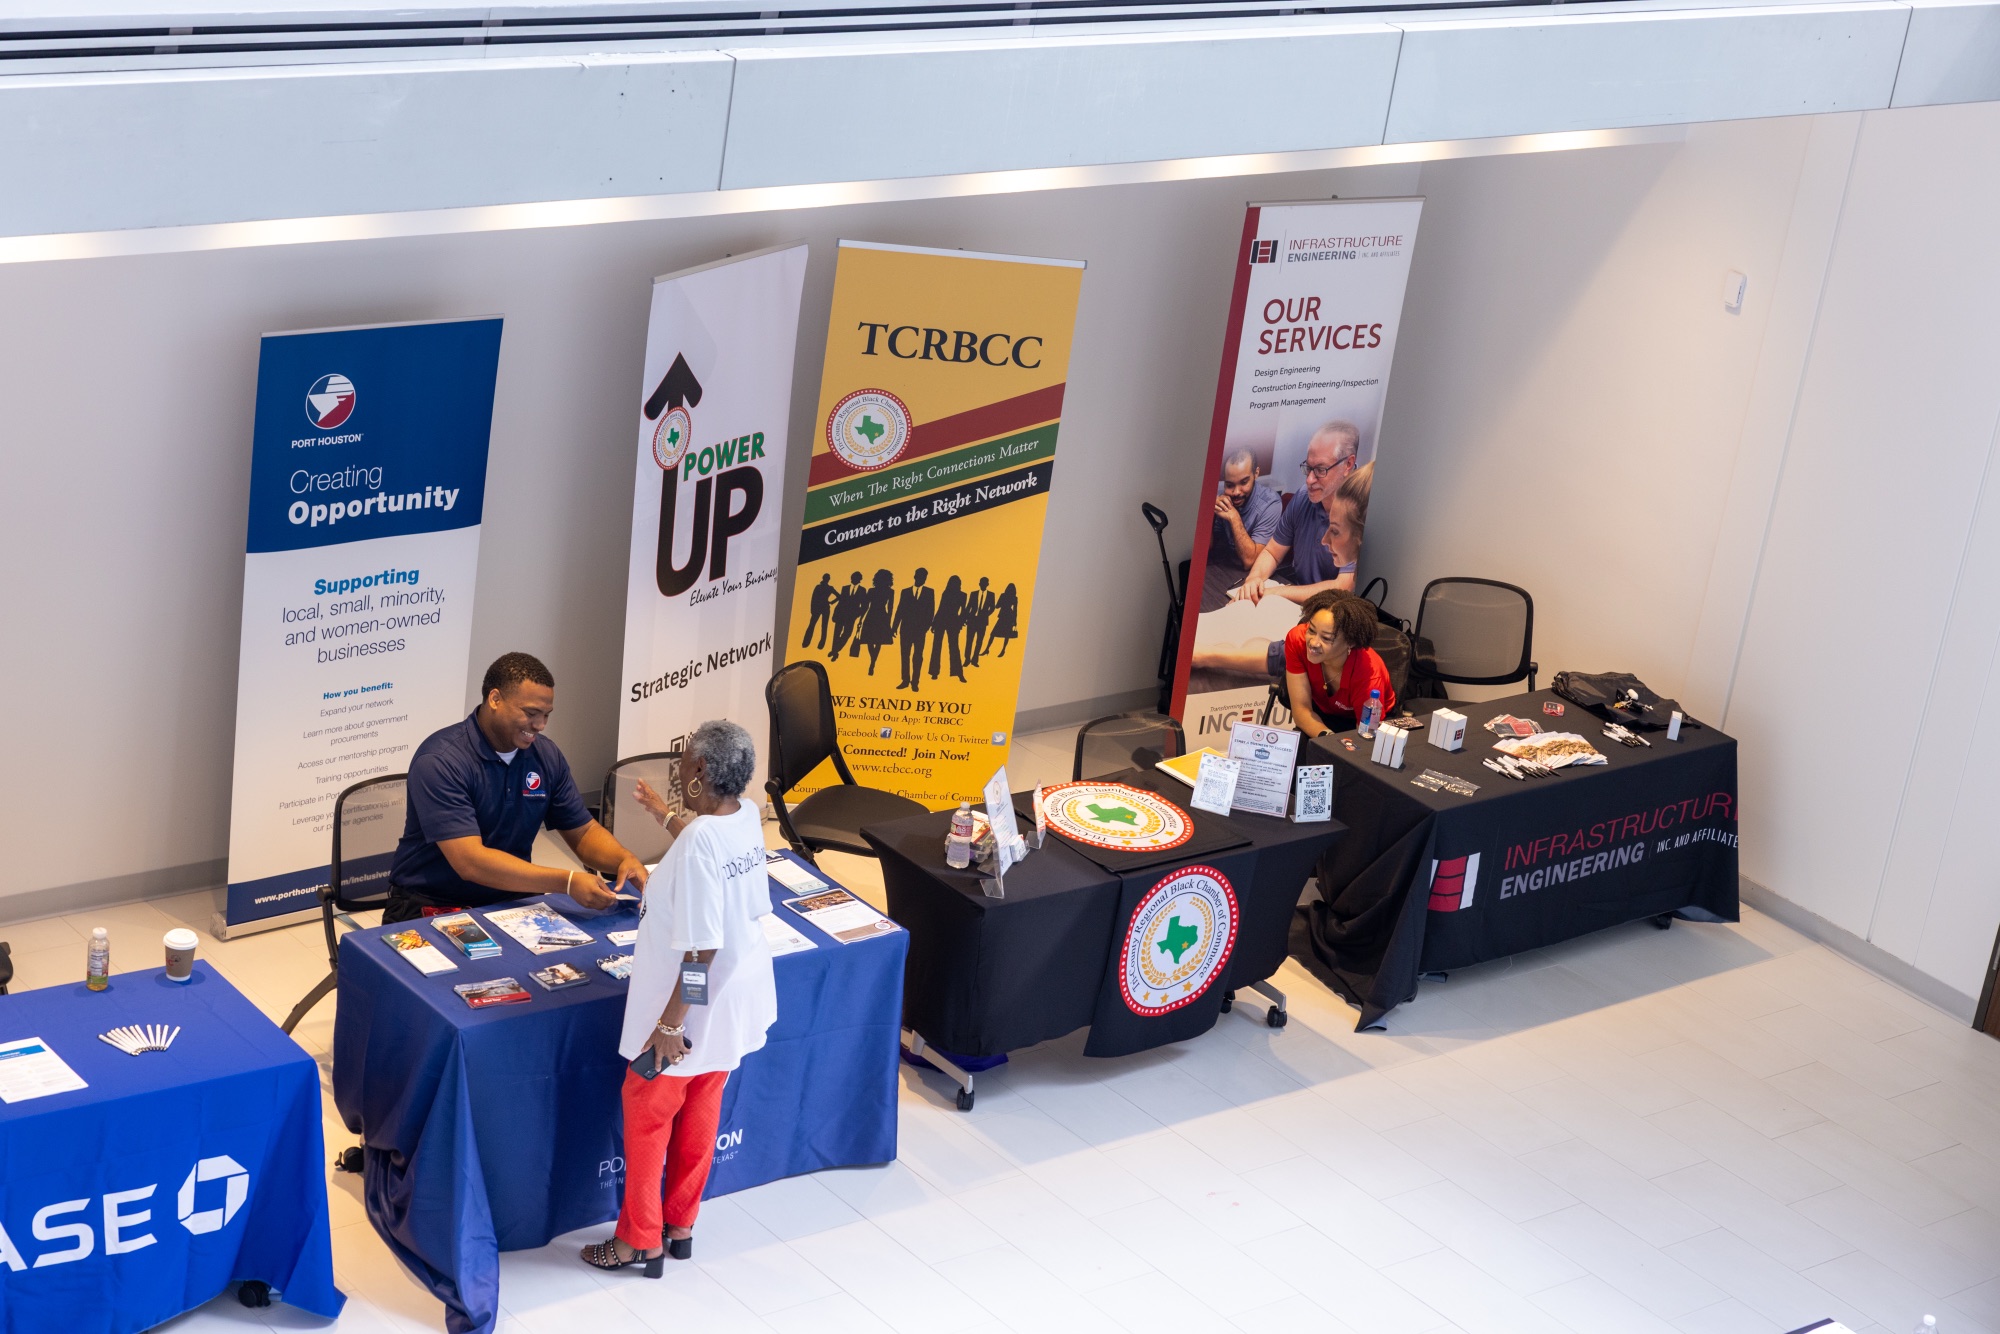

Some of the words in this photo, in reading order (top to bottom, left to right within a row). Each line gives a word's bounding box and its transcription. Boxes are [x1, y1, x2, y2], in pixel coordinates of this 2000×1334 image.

[1289, 235, 1403, 250] INFRASTRUCTURE
[1287, 250, 1357, 263] ENGINEERING
[1263, 296, 1321, 325] OUR
[858, 321, 1043, 369] TCRBCC
[1257, 323, 1383, 355] SERVICES
[1254, 367, 1279, 378] Design
[1279, 364, 1321, 376] Engineering
[1252, 382, 1297, 394] Construction
[1297, 377, 1379, 390] Engineering/Inspection
[838, 398, 861, 419] Regional
[880, 398, 901, 419] Chamber
[1249, 399, 1280, 410] Program
[1280, 396, 1326, 408] Management
[291, 437, 317, 449] PORT
[317, 433, 362, 447] HOUSTON
[834, 420, 845, 451] Tri-County
[886, 425, 905, 456] Commerce
[683, 431, 766, 482] POWER
[290, 464, 383, 494] Creating
[829, 490, 864, 508] When
[867, 481, 889, 497] The
[892, 471, 924, 490] Right
[926, 452, 996, 480] Connections
[998, 438, 1040, 461] Matter
[288, 485, 460, 528] Opportunity
[823, 516, 884, 546] Connect
[887, 511, 902, 529] to
[905, 504, 928, 524] the
[931, 491, 973, 517] Right
[974, 471, 1038, 504] Network
[656, 465, 764, 597] UP
[314, 568, 420, 595] Supporting
[689, 586, 719, 607] Elevate
[722, 579, 743, 596] Your
[282, 603, 324, 623] local,
[330, 595, 374, 616] small,
[380, 587, 445, 608] minority,
[285, 626, 316, 646] and
[321, 608, 441, 640] women-owned
[317, 638, 406, 663] businesses
[630, 659, 702, 703] Strategic
[706, 632, 772, 674] Network
[323, 690, 342, 700] How
[343, 688, 359, 699] you
[361, 682, 393, 694] benefit:
[320, 705, 347, 718] Expand
[348, 702, 364, 714] your
[365, 698, 394, 709] network
[831, 695, 856, 708] WE
[858, 697, 912, 711] STAND
[915, 700, 935, 713] BY
[938, 702, 973, 715] YOU
[1210, 703, 1244, 712] Transforming
[303, 729, 323, 739] Learn
[324, 726, 343, 735] more
[344, 721, 365, 732] about
[366, 714, 408, 729] government
[838, 711, 881, 722] Download
[882, 713, 899, 723] Our
[901, 715, 921, 725] App:
[923, 716, 964, 726] TCRBCC
[330, 730, 379, 746] procurements
[837, 727, 878, 738] Facebook
[894, 731, 924, 741] Follow
[926, 733, 939, 742] Us
[940, 734, 956, 743] On
[958, 734, 990, 745] Twitter
[297, 759, 324, 770] Access
[325, 757, 337, 765] our
[338, 748, 378, 762] mentorship
[378, 743, 409, 756] program
[843, 744, 908, 758] Connected!
[911, 748, 936, 761] Join
[939, 750, 971, 762] Now!
[315, 774, 342, 785] Training
[343, 765, 389, 780] opportunities
[852, 763, 933, 778] www.tcbcc.org
[279, 796, 316, 810] Participate
[317, 794, 325, 802] in
[325, 791, 340, 801] Port
[896, 790, 937, 800] Chamber
[939, 792, 950, 801] of
[951, 793, 985, 802] Comme
[1058, 787, 1082, 798] Black
[1086, 787, 1134, 799] Chamber
[292, 813, 325, 826] Leverage
[342, 800, 390, 815] certification(s)
[1051, 796, 1064, 818] Regional
[1149, 801, 1178, 829] Commerce
[313, 824, 324, 833] our
[352, 813, 384, 826] agencies
[1059, 818, 1109, 843] Tri-County
[1504, 792, 1739, 871] INFRASTRUCTUR
[1500, 841, 1645, 900] ENGINEERING
[1657, 836, 1671, 853] INC.
[1674, 833, 1690, 849] AND
[1691, 828, 1739, 849] AFFILIATE
[1170, 879, 1194, 895] Black
[1196, 879, 1223, 909] Chamber
[1134, 890, 1169, 934] Regional
[1218, 910, 1227, 920] of
[1199, 921, 1227, 979] Commerce
[1129, 938, 1140, 992] Tri-County
[599, 1156, 626, 1178] PO
[600, 1179, 613, 1190] THE
